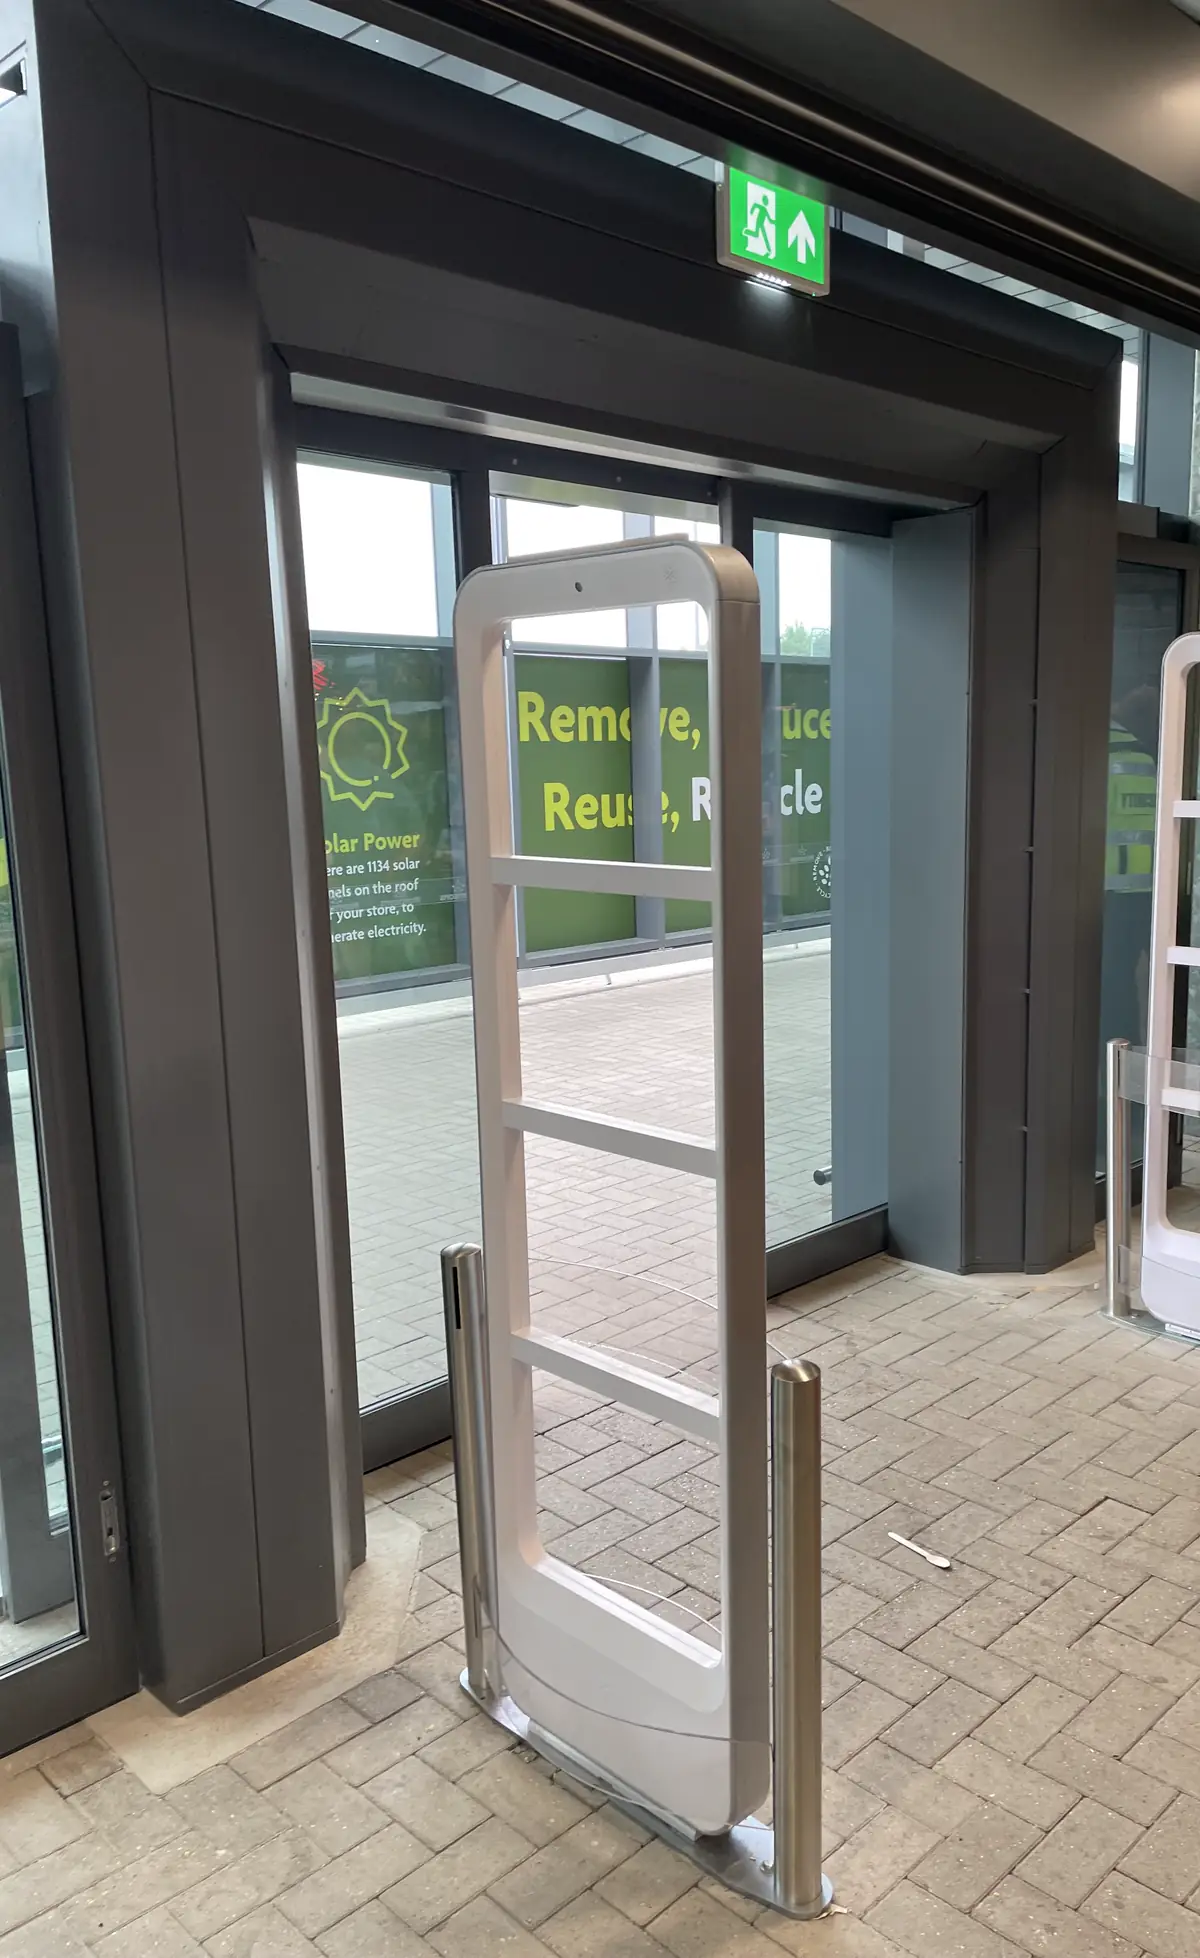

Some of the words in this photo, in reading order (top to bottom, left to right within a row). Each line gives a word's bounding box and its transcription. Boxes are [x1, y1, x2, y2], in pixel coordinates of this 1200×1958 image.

[543, 782, 680, 832] Reu,
[325, 832, 359, 854] olar
[363, 832, 420, 851] Power
[326, 866, 343, 877] ere
[346, 863, 365, 875] are
[367, 859, 390, 873] 1134
[393, 857, 420, 871] solar
[328, 884, 352, 899] nels
[354, 885, 370, 896] on
[372, 880, 392, 894] the
[395, 877, 420, 892] roof
[336, 908, 364, 924] your
[366, 905, 399, 917] store,
[401, 902, 415, 913] to
[331, 929, 365, 943] erate
[367, 921, 427, 939] electricity.
